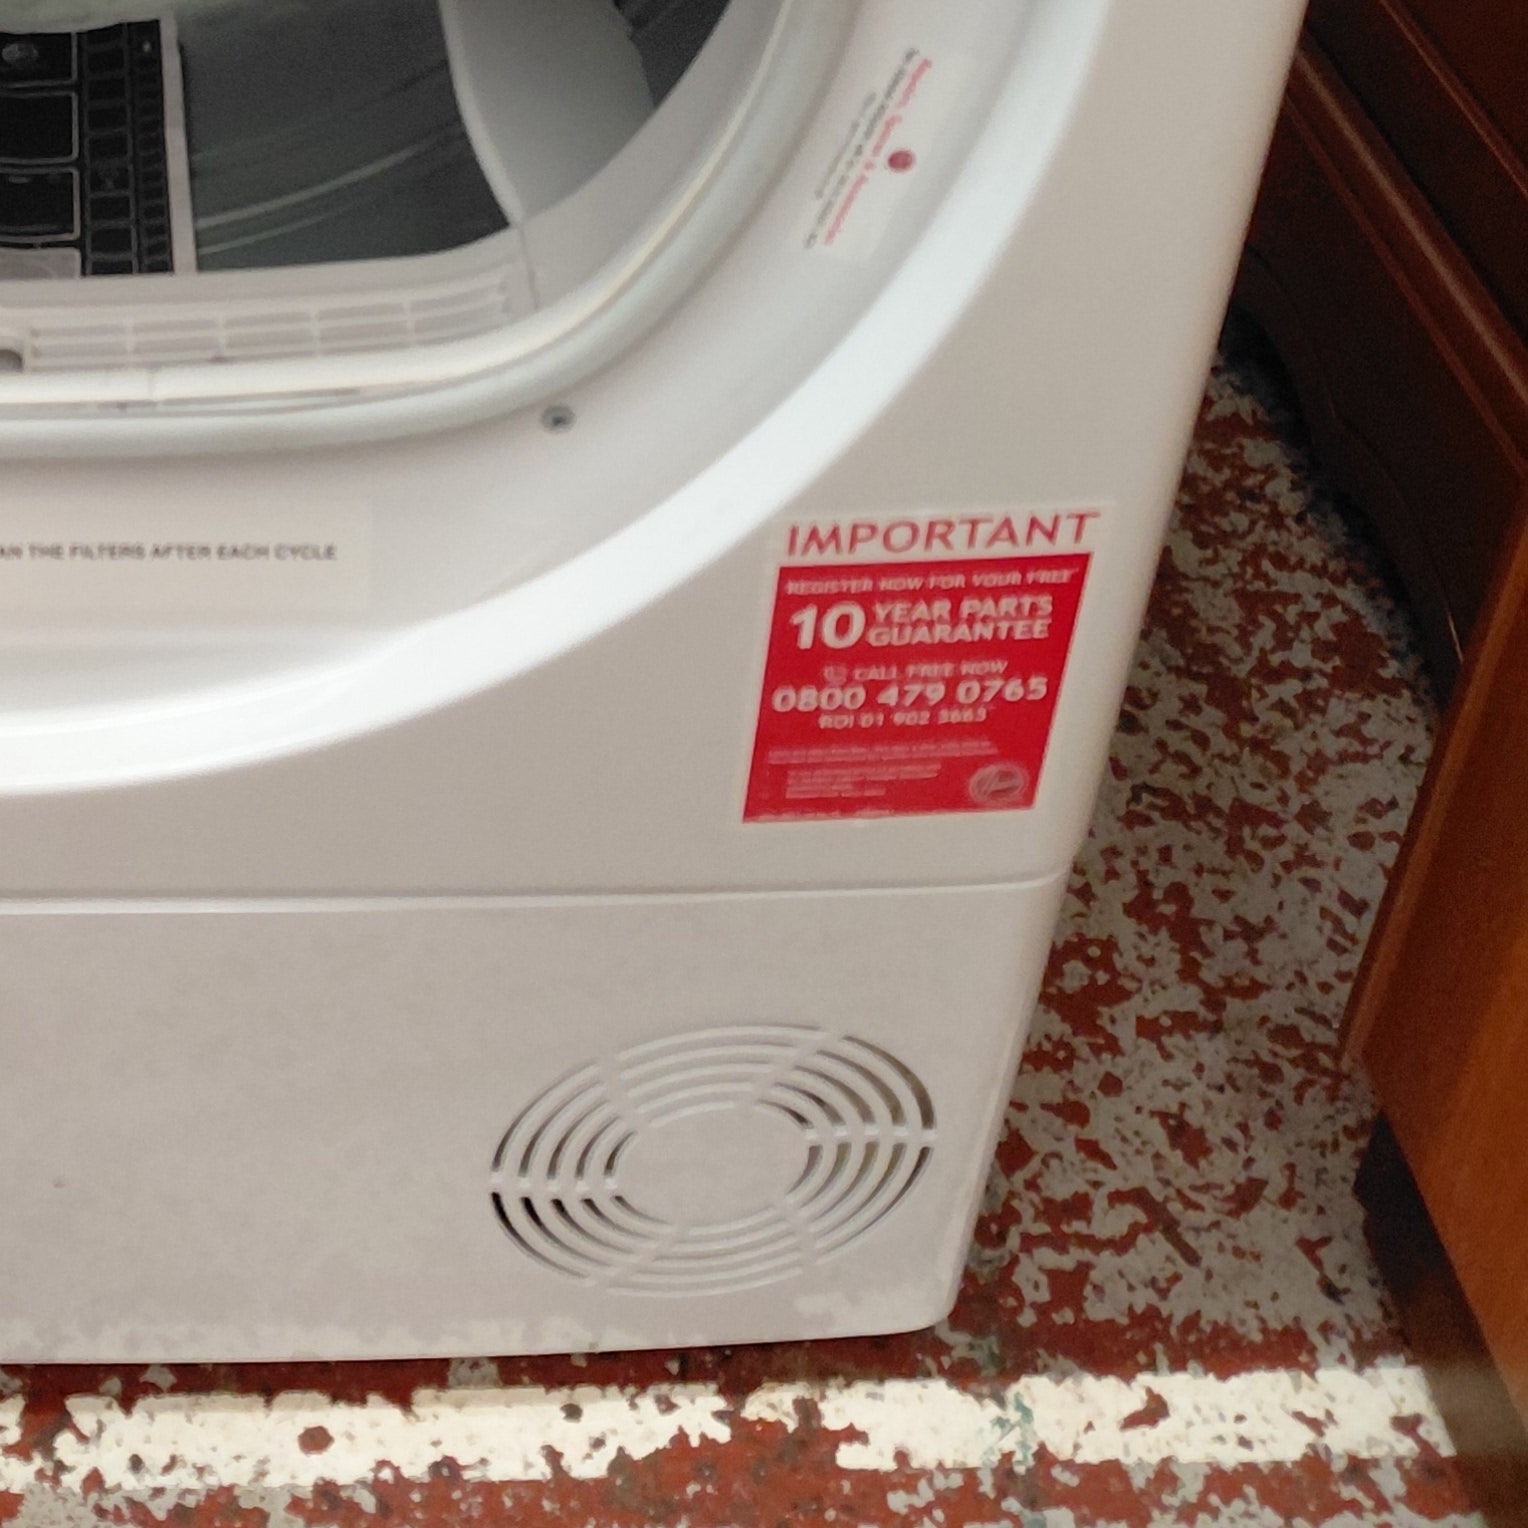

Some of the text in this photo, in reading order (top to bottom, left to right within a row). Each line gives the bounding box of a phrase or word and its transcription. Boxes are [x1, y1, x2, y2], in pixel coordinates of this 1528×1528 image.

[786, 511, 1101, 556] IMPORTANT
[28, 542, 65, 560] THE
[69, 543, 145, 560] FILTERS
[151, 543, 211, 561] AFTER
[217, 542, 270, 560] EACH
[275, 543, 337, 560] CYCLE
[874, 594, 1053, 623] YEAR PARTS
[790, 600, 866, 650] 10
[867, 620, 1051, 646] GUARANTEE
[854, 666, 897, 681] CALL
[960, 660, 1008, 676] NOW
[773, 676, 1048, 713] 0800 479 0765
[860, 712, 884, 727] 01
